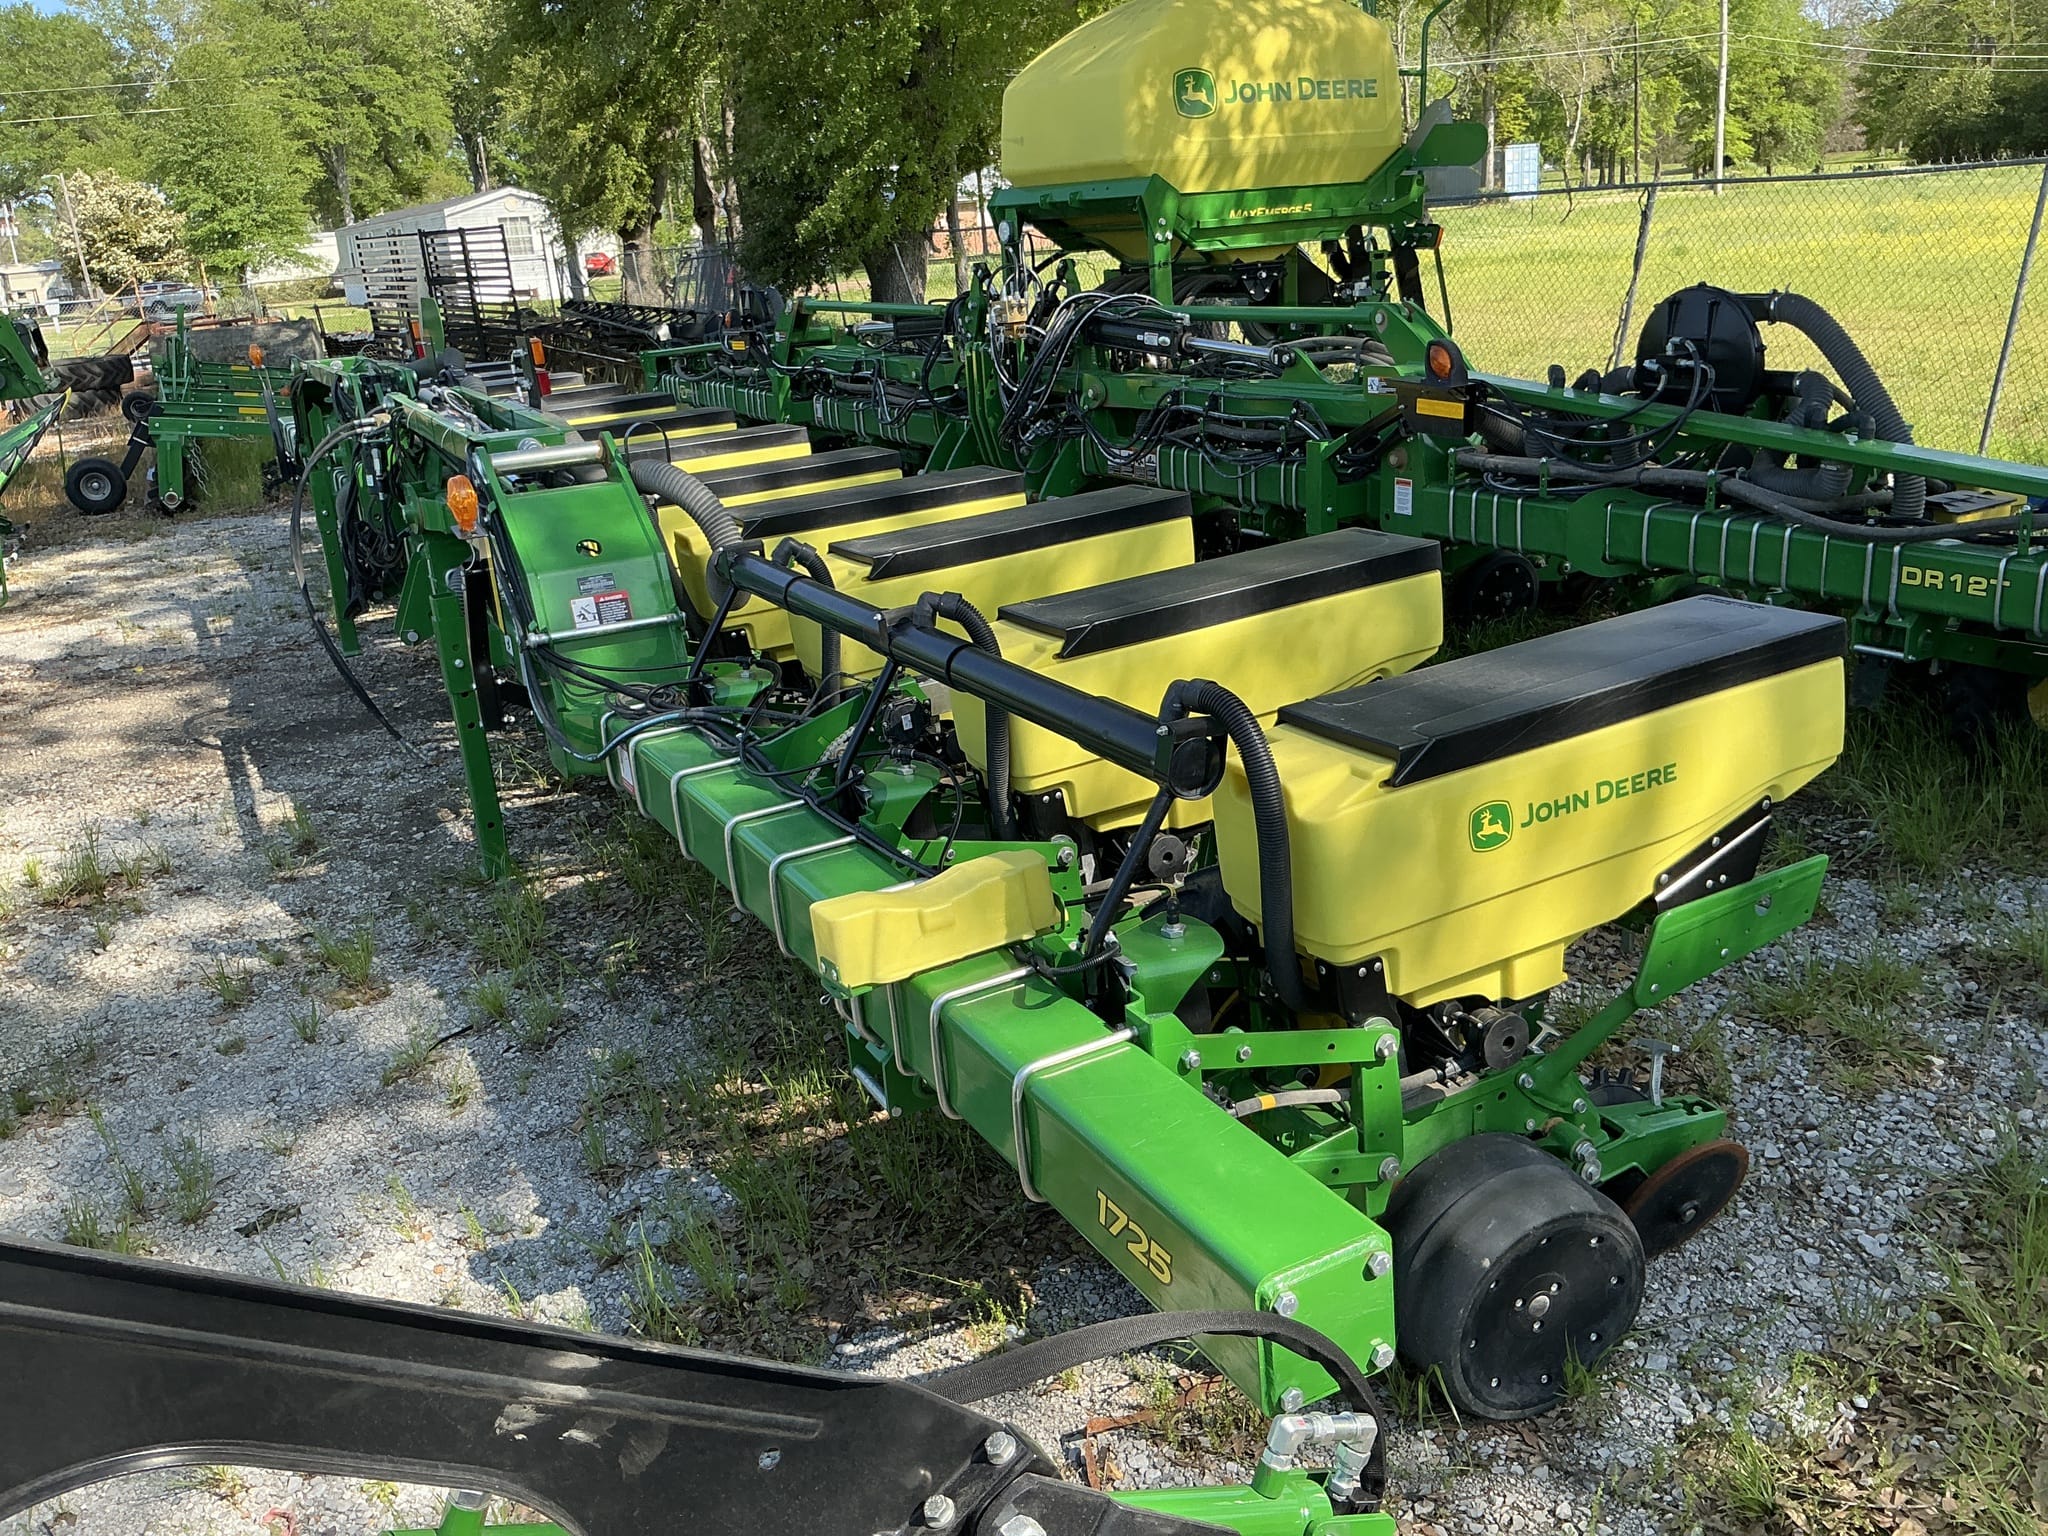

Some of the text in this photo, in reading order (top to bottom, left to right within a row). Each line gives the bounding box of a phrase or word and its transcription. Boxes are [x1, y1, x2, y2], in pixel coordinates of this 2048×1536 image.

[1225, 77, 1378, 103] JOHN DEERE
[1520, 762, 1678, 828] JOHN DEERE
[1096, 1189, 1173, 1285] 1725
